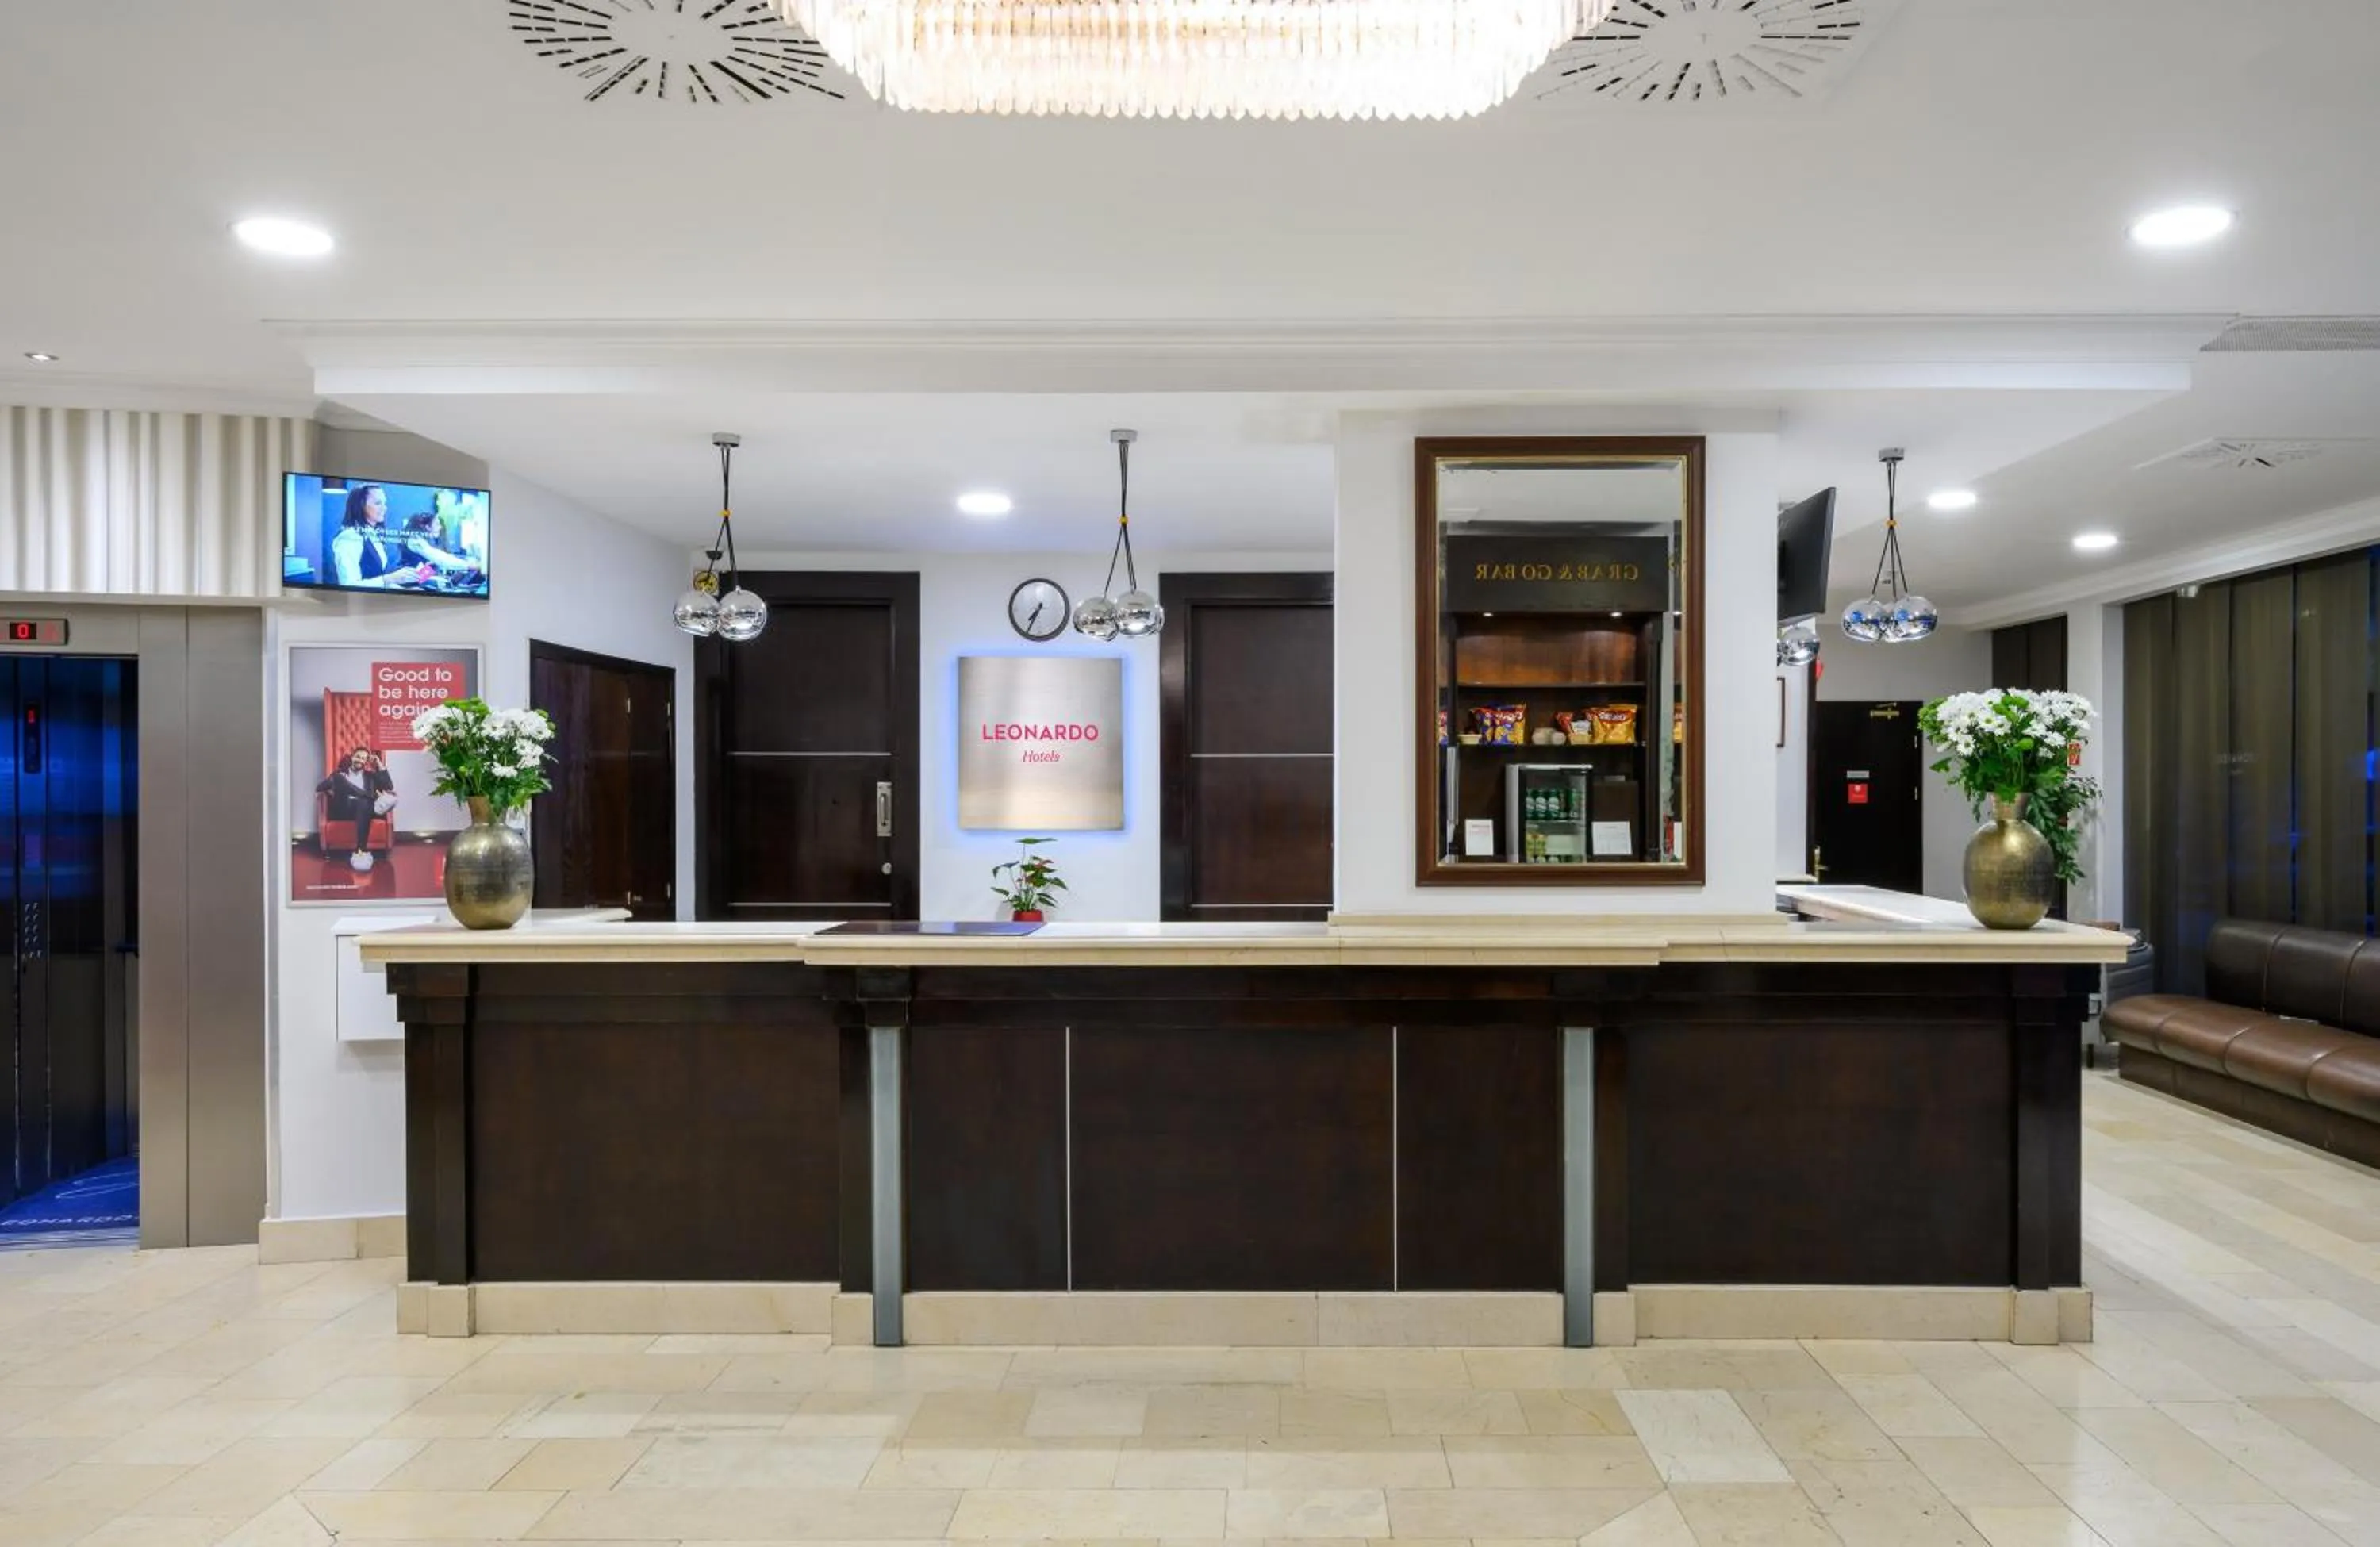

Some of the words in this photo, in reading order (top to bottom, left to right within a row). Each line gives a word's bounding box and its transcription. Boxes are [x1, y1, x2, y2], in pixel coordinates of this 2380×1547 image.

[378, 667, 429, 681] Good
[435, 668, 452, 681] to
[378, 685, 402, 699] be
[409, 685, 448, 699] here
[982, 723, 1099, 741] LEONARDO
[1023, 750, 1061, 762] Hotels
